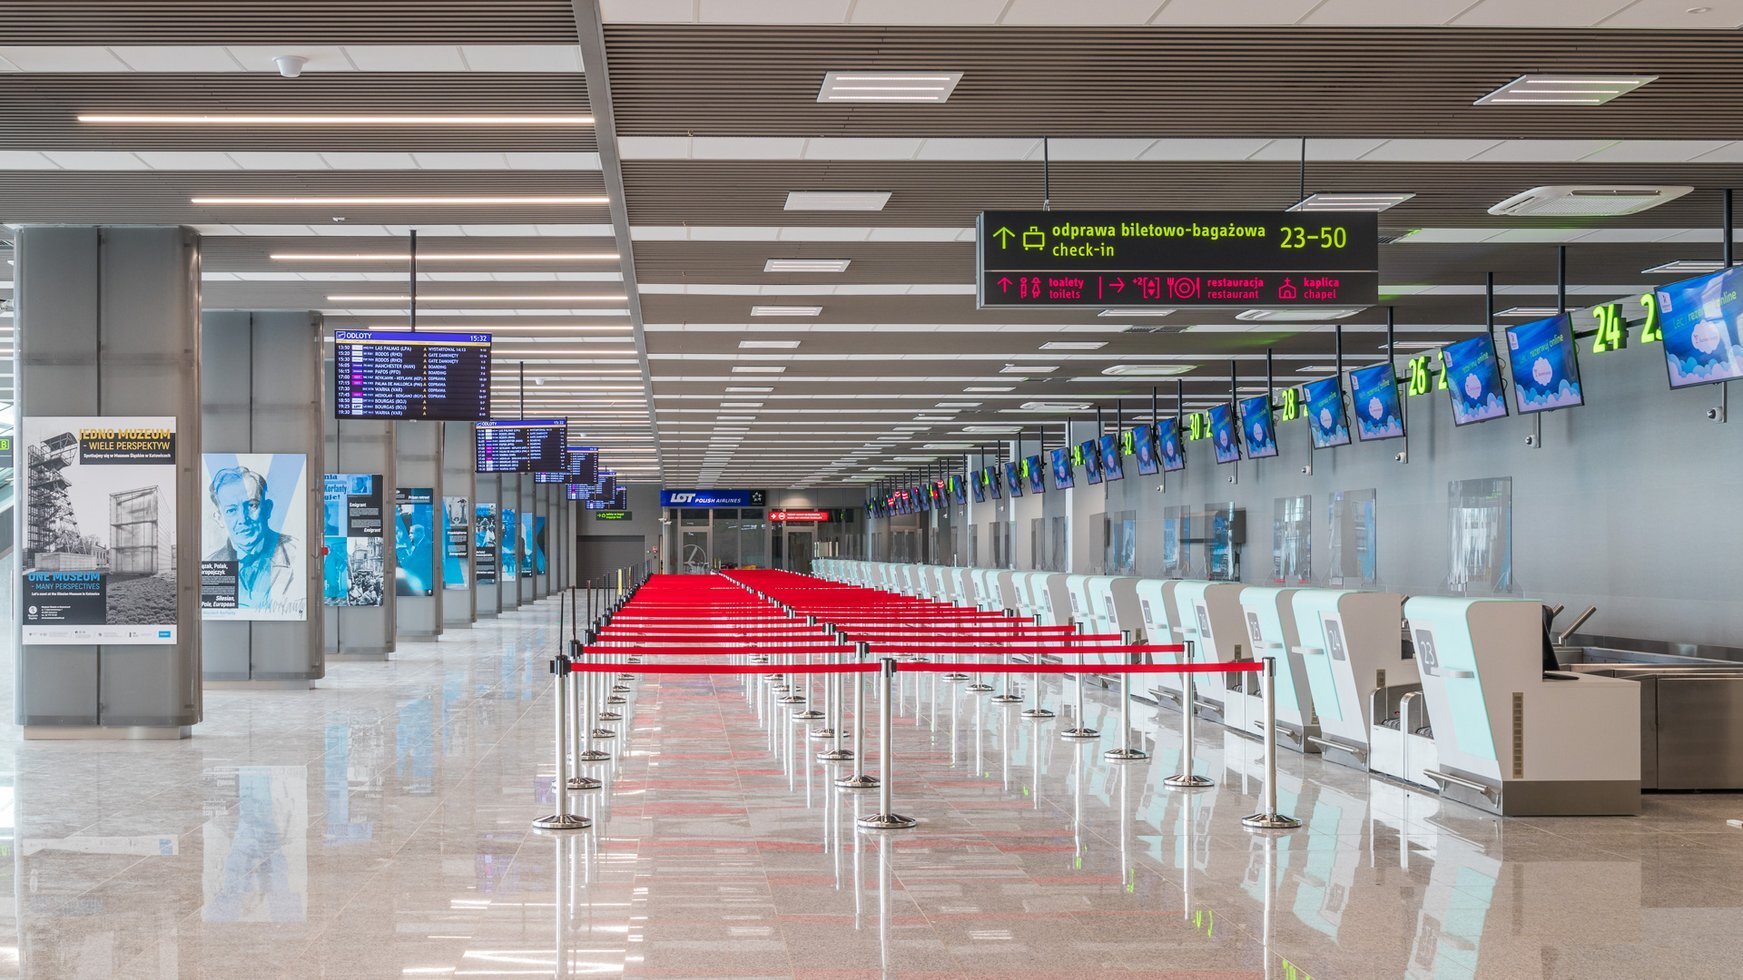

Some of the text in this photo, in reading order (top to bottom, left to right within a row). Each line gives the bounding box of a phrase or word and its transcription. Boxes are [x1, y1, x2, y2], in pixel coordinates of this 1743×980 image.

[1052, 223, 1347, 248] odprawa biletowo-bagażowa 23-50
[1052, 243, 1115, 256] check-in
[1049, 277, 1084, 288] toalety
[1207, 278, 1264, 288] restauracja
[1304, 278, 1340, 288] kaplica
[1049, 289, 1337, 300] toilets restaurant chapel
[1593, 304, 1620, 353] 24
[1641, 294, 1663, 343] 2
[1409, 356, 1426, 396] 26
[1282, 388, 1294, 421] 28
[79, 428, 170, 440] JEDNO MUZEUM
[1190, 413, 1199, 440] 30
[89, 442, 114, 450] WIELE
[117, 442, 170, 450] PERSPEKTYW
[670, 493, 696, 502] LOT
[28, 571, 100, 581] ONE MUSEUM
[1329, 630, 1341, 651] 24
[1420, 641, 1435, 665] 23
